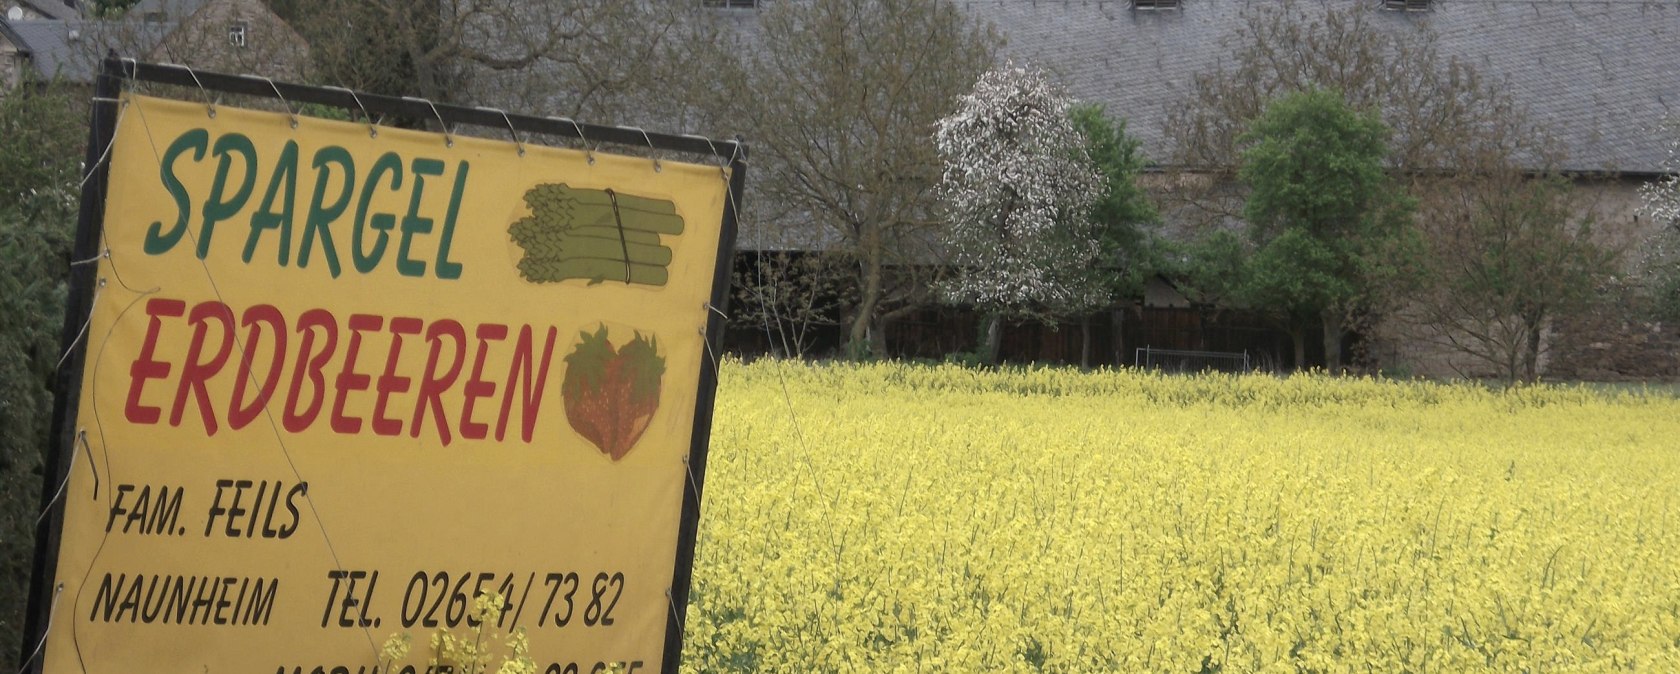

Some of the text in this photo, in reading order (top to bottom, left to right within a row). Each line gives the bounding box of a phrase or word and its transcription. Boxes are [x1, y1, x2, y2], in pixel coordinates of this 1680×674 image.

[143, 128, 470, 280] SPARGEL
[124, 298, 558, 447] ERDBEEREN
[107, 479, 308, 539] FAM. FEILS
[90, 573, 279, 626] NAUNHEIM
[321, 570, 381, 628] TEL.
